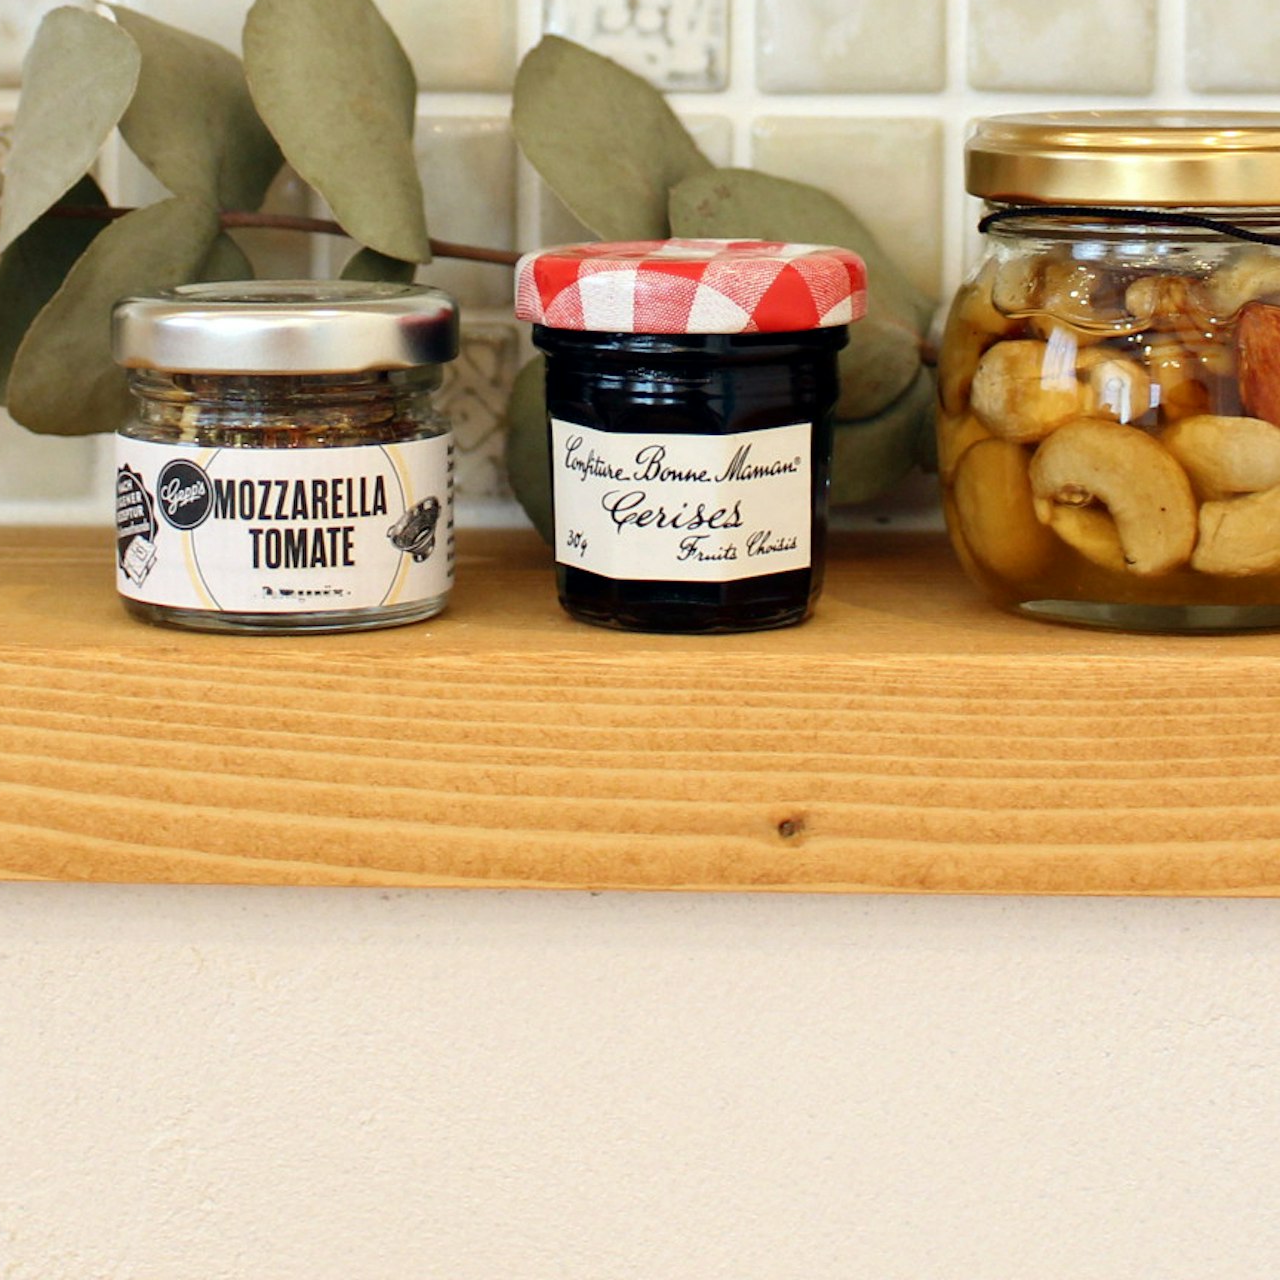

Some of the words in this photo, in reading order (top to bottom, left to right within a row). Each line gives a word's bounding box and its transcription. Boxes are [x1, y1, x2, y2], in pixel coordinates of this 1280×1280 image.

[565, 434, 629, 482] Confiture
[634, 444, 711, 483] Bonne
[214, 475, 388, 521] MOZZARELLA
[601, 489, 744, 535] Cerises
[248, 526, 355, 570] TOMATE
[676, 534, 738, 562] Fruits
[746, 529, 798, 557] Choisis
